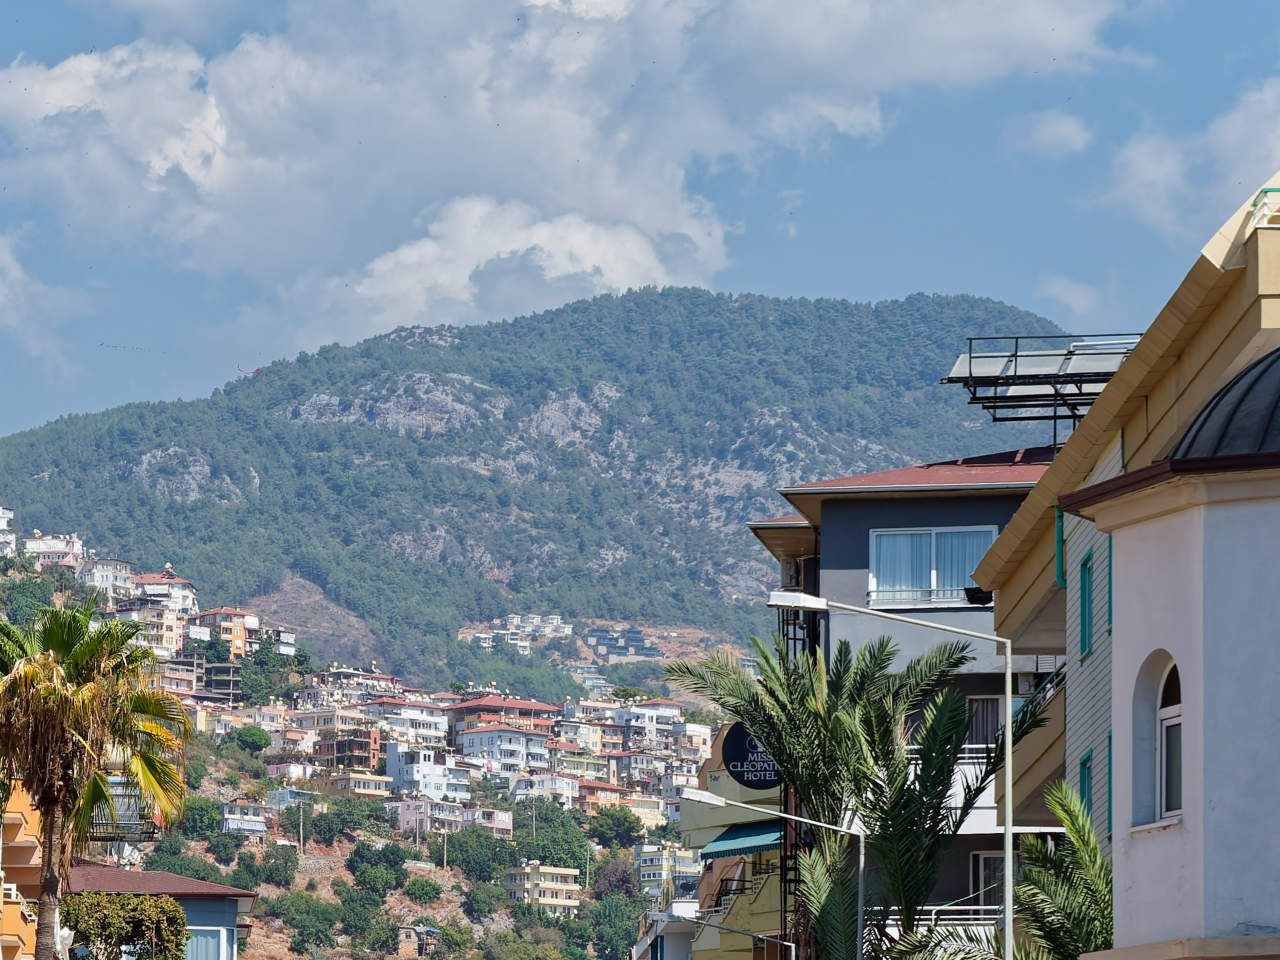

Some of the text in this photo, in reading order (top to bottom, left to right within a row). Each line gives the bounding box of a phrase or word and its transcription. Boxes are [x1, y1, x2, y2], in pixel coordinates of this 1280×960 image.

[747, 752, 773, 762] MISS
[729, 761, 780, 771] CLEOPAT
[744, 771, 778, 780] HOTEL
